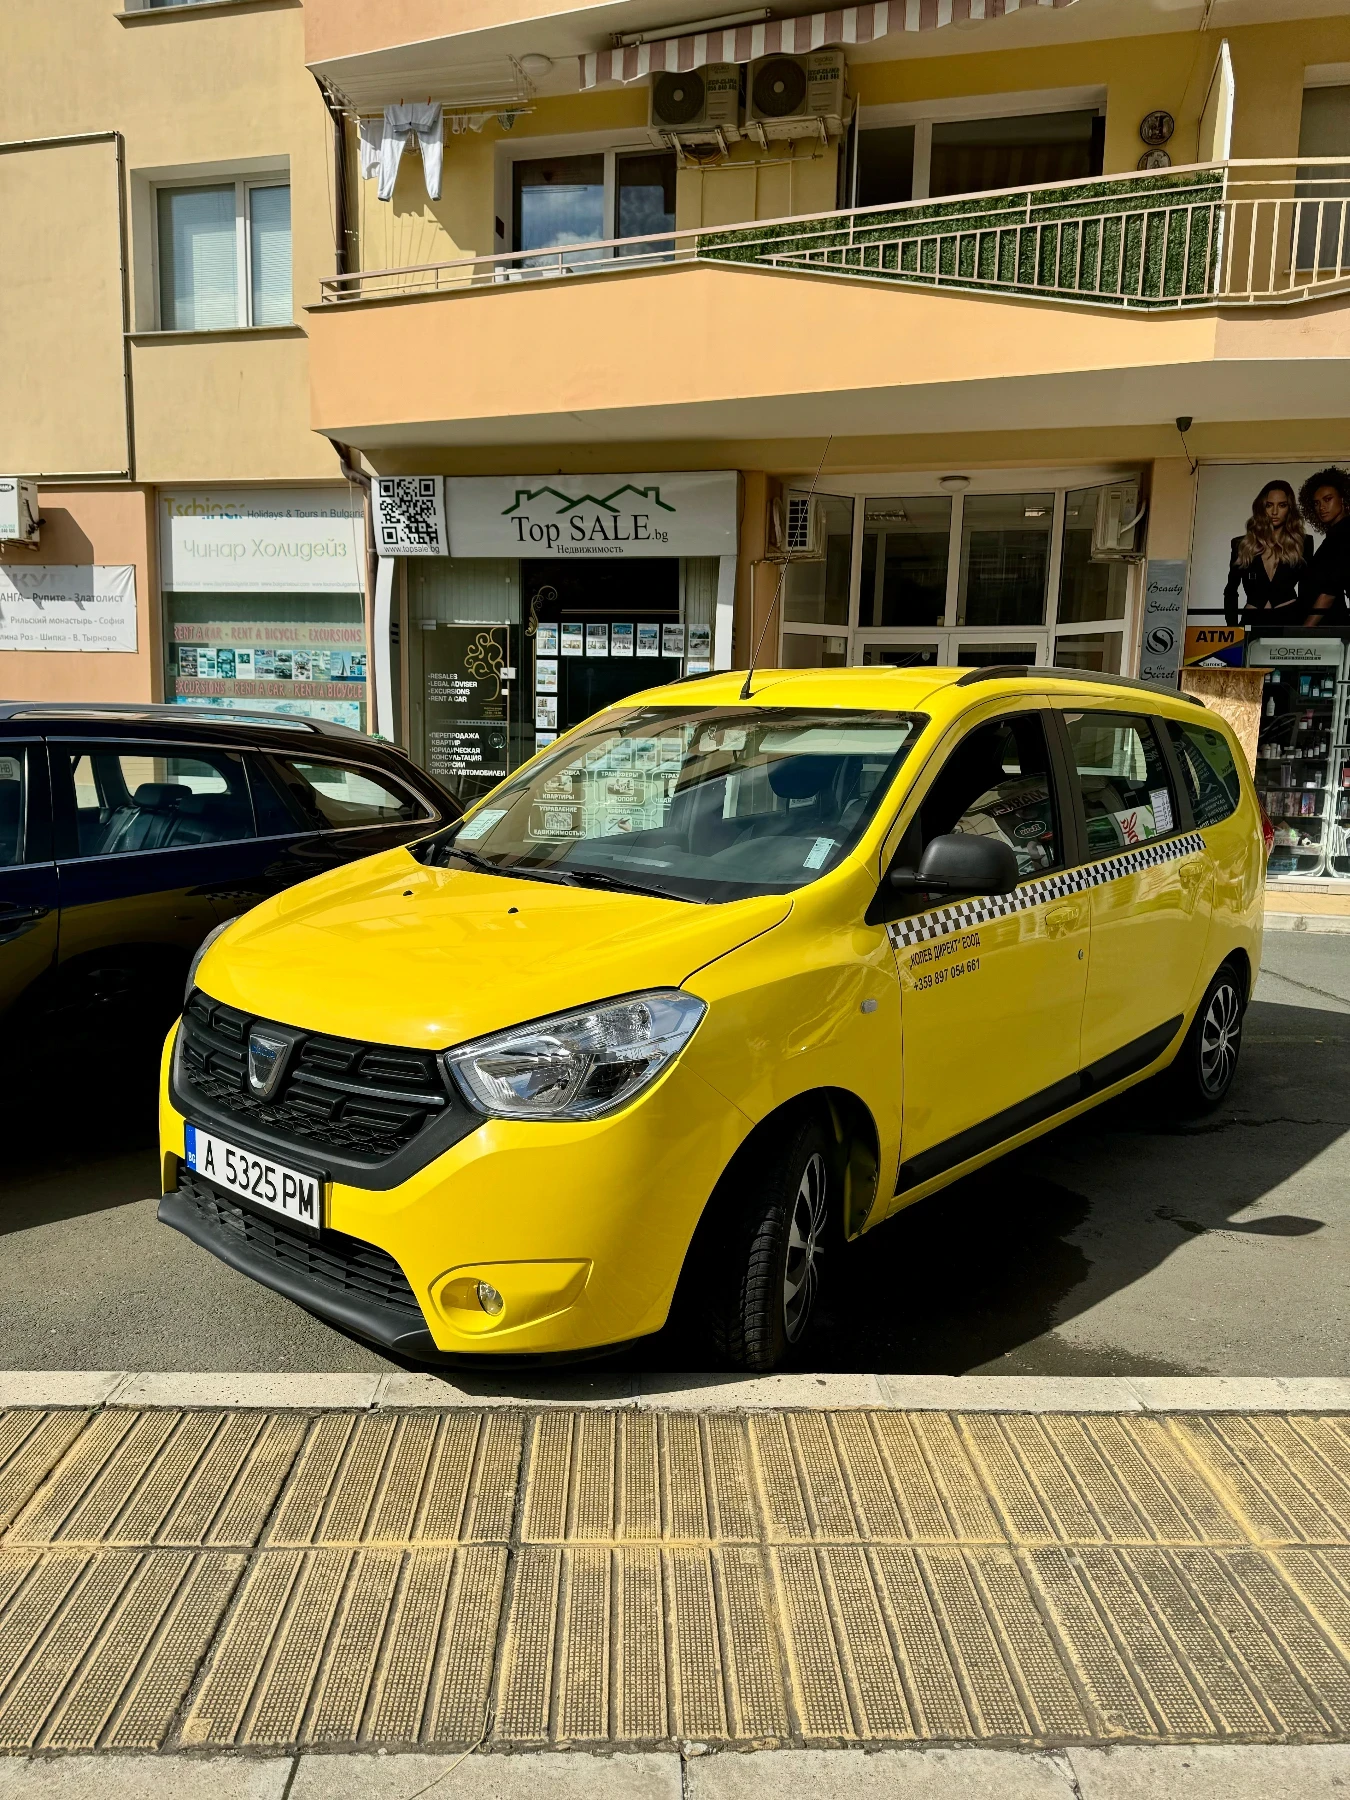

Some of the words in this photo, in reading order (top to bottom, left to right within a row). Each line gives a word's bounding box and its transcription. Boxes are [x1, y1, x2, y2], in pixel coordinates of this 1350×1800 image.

[247, 510, 284, 520] Holidays
[286, 510, 292, 518] &
[294, 510, 318, 518] Tours
[320, 509, 328, 518] in
[511, 516, 560, 548] Top
[184, 539, 246, 562] Чинар
[252, 538, 347, 562] Холидейз
[384, 544, 440, 554] www.topsale.bg
[556, 544, 624, 554] Недвижимость
[1147, 582, 1183, 596] Beauty
[32, 592, 66, 604] Рупите
[74, 592, 124, 603] Златолист
[1146, 600, 1180, 614] Studio
[10, 616, 46, 625] Рильский
[48, 617, 92, 626] монастырь
[98, 616, 125, 626] София
[20, 633, 34, 641] Роз
[40, 634, 66, 642] Шипка
[84, 634, 117, 642] Тырново
[174, 626, 194, 640] RENT
[196, 627, 204, 640] A
[204, 627, 222, 640] CAR
[231, 627, 253, 640] RENT
[256, 628, 264, 640] A
[264, 628, 298, 642] BICYCLE
[308, 628, 362, 642] EXCURSIONS
[1196, 630, 1235, 642] ATM
[1156, 664, 1166, 672] the
[1140, 669, 1176, 681] Secret
[176, 680, 225, 694] EXCURSIONS
[234, 681, 256, 694] RENT
[258, 682, 264, 694] A
[268, 683, 285, 696] CAR
[294, 683, 316, 696] RENT
[318, 684, 324, 696] A
[326, 684, 362, 698] BICYCLE
[432, 732, 480, 740] ПЕРЕПРОДАЖА
[962, 933, 980, 950] ЕООД
[914, 974, 932, 990] +359
[934, 968, 948, 984] 897
[950, 962, 964, 978] 054
[966, 958, 980, 972] 661
[188, 1152, 196, 1164] BG
[204, 1140, 216, 1176] A
[226, 1148, 278, 1202] 5325
[282, 1172, 314, 1220] PM
